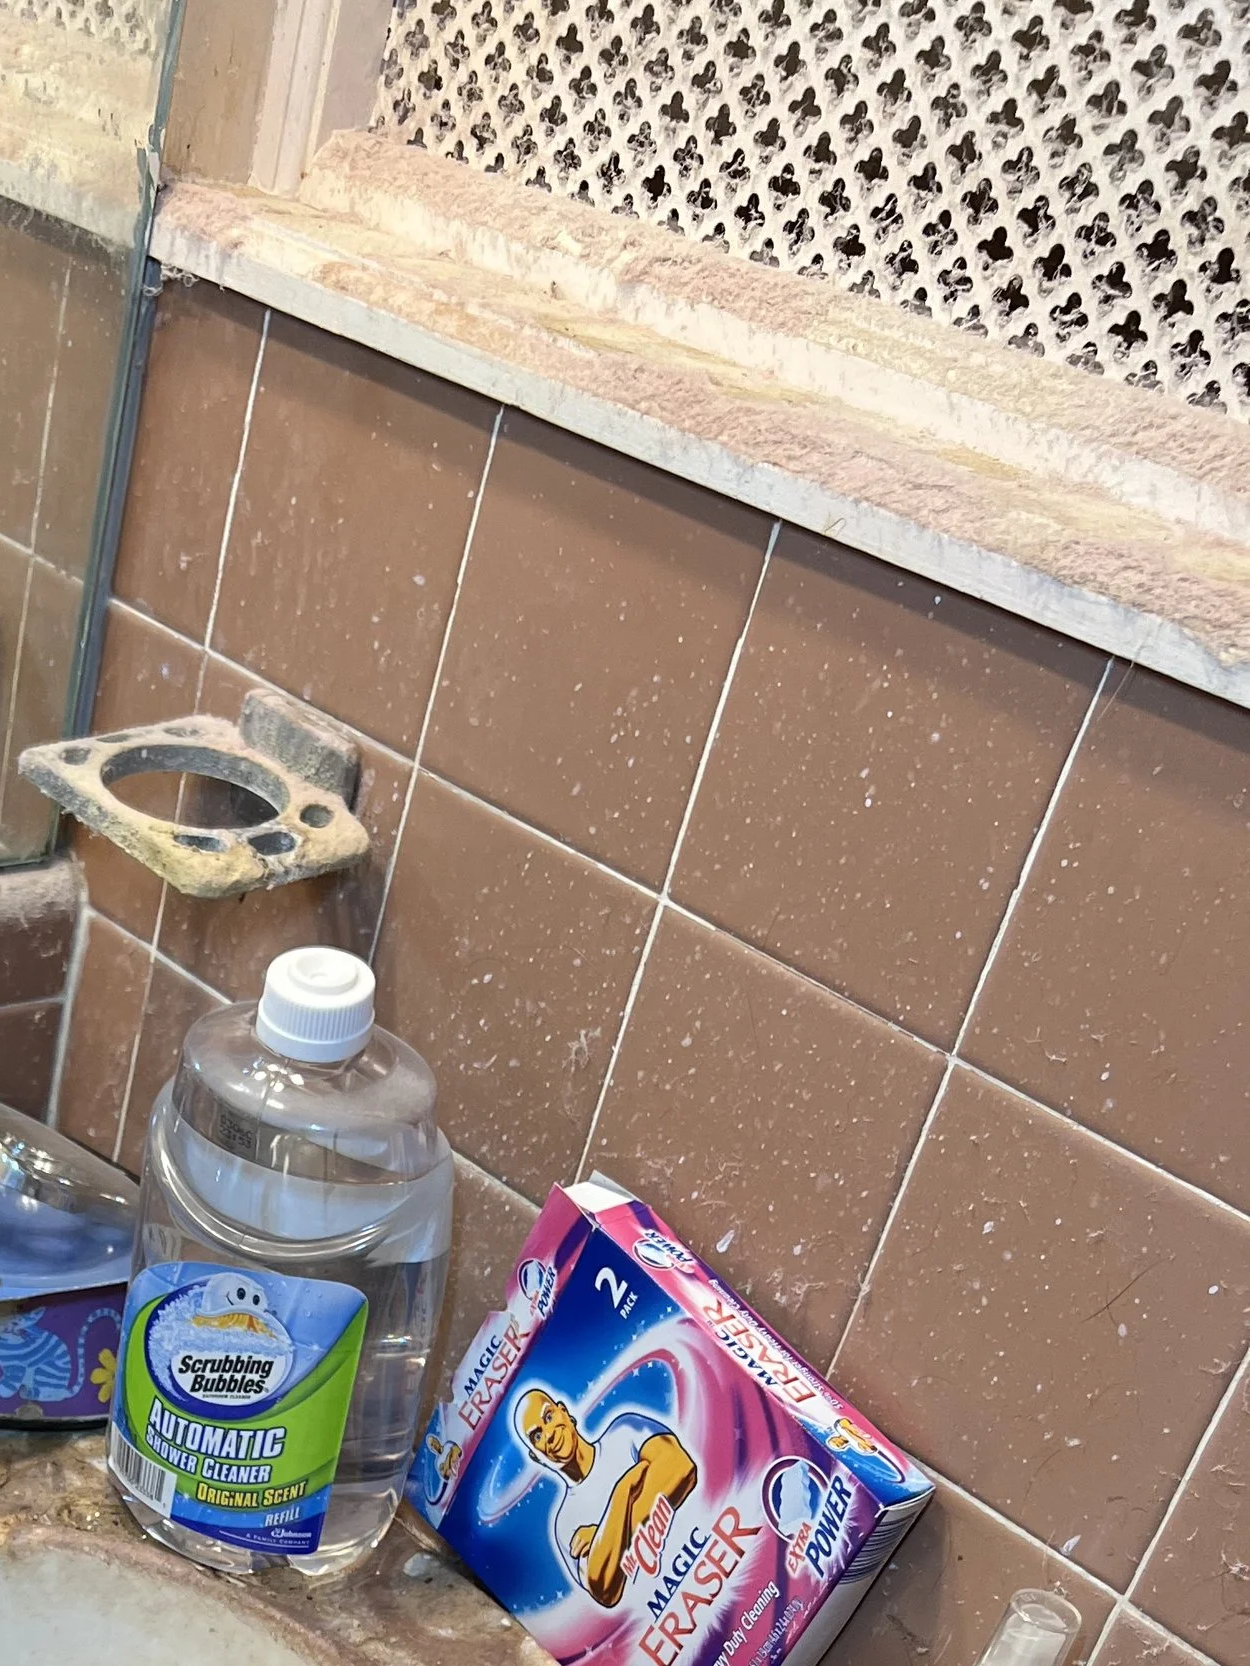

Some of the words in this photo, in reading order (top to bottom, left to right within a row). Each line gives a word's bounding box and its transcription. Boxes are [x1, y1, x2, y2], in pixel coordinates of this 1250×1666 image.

[537, 1266, 556, 1317] POWER
[595, 1266, 629, 1310] 2
[619, 1291, 639, 1319] PACK
[178, 1355, 274, 1379] Scrubbing
[458, 1322, 530, 1431] ERASER
[463, 1334, 502, 1398] MAGIC
[702, 1299, 818, 1404] ERASER
[716, 1325, 778, 1387] MAGIC
[190, 1374, 266, 1394] Bubbles
[146, 1425, 197, 1474] SHOWER
[202, 1457, 271, 1483] CLEANER
[149, 1397, 287, 1460] AUTOMATIC
[197, 1482, 259, 1508] ORIGINAL
[263, 1481, 307, 1506] SCENT
[264, 1506, 300, 1527] REFILL
[634, 1496, 672, 1576] Clean
[789, 1522, 812, 1575] EXTRA
[805, 1475, 852, 1578] POWER
[646, 1526, 711, 1620] MAGIC
[723, 1628, 749, 1657] Duty
[740, 1580, 781, 1631] Cleaning
